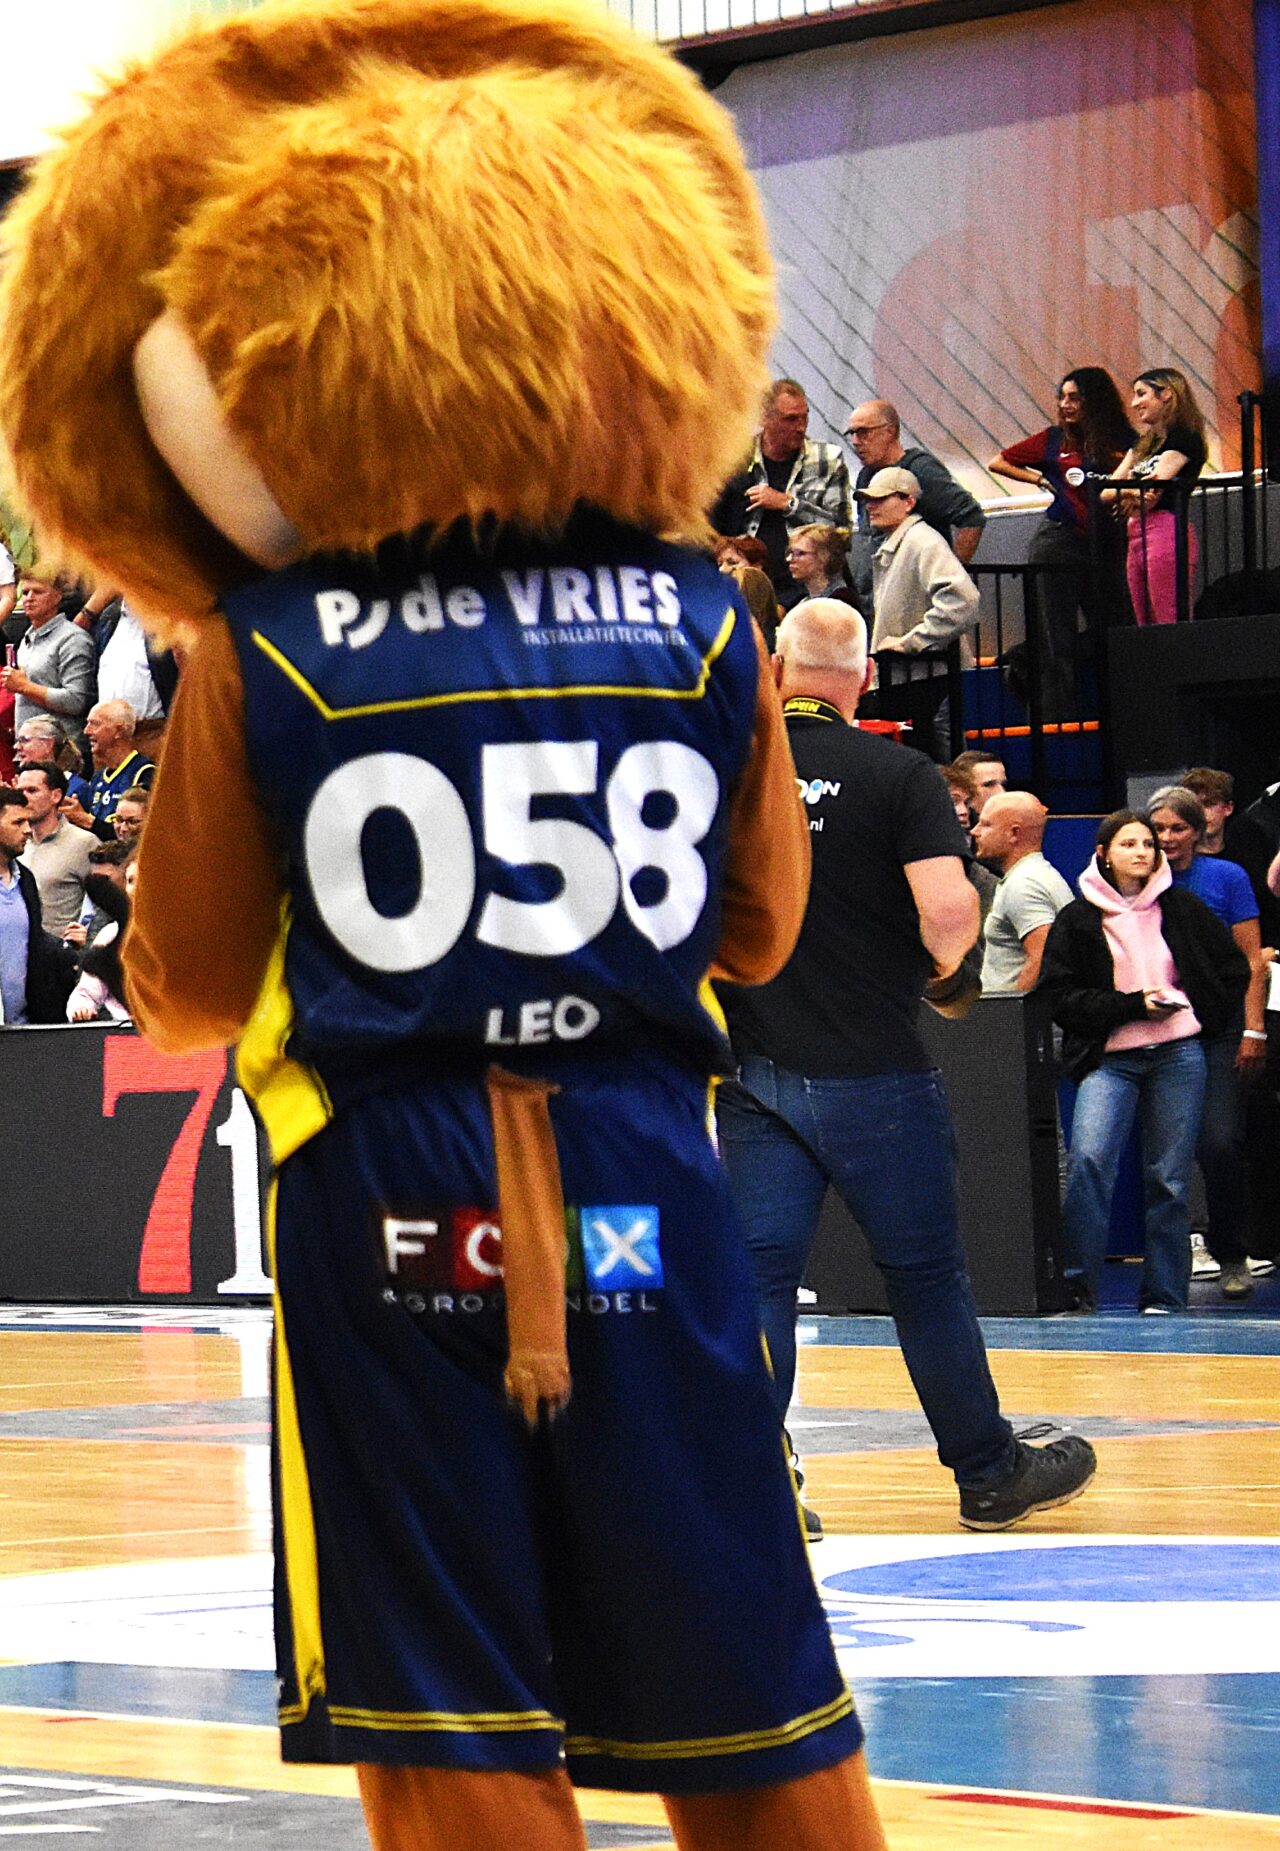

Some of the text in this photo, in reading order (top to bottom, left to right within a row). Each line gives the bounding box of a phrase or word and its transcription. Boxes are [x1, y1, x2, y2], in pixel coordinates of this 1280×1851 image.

[400, 574, 486, 633] de
[500, 566, 682, 628] VRIES
[305, 740, 719, 972] 058
[486, 996, 599, 1044] LEO
